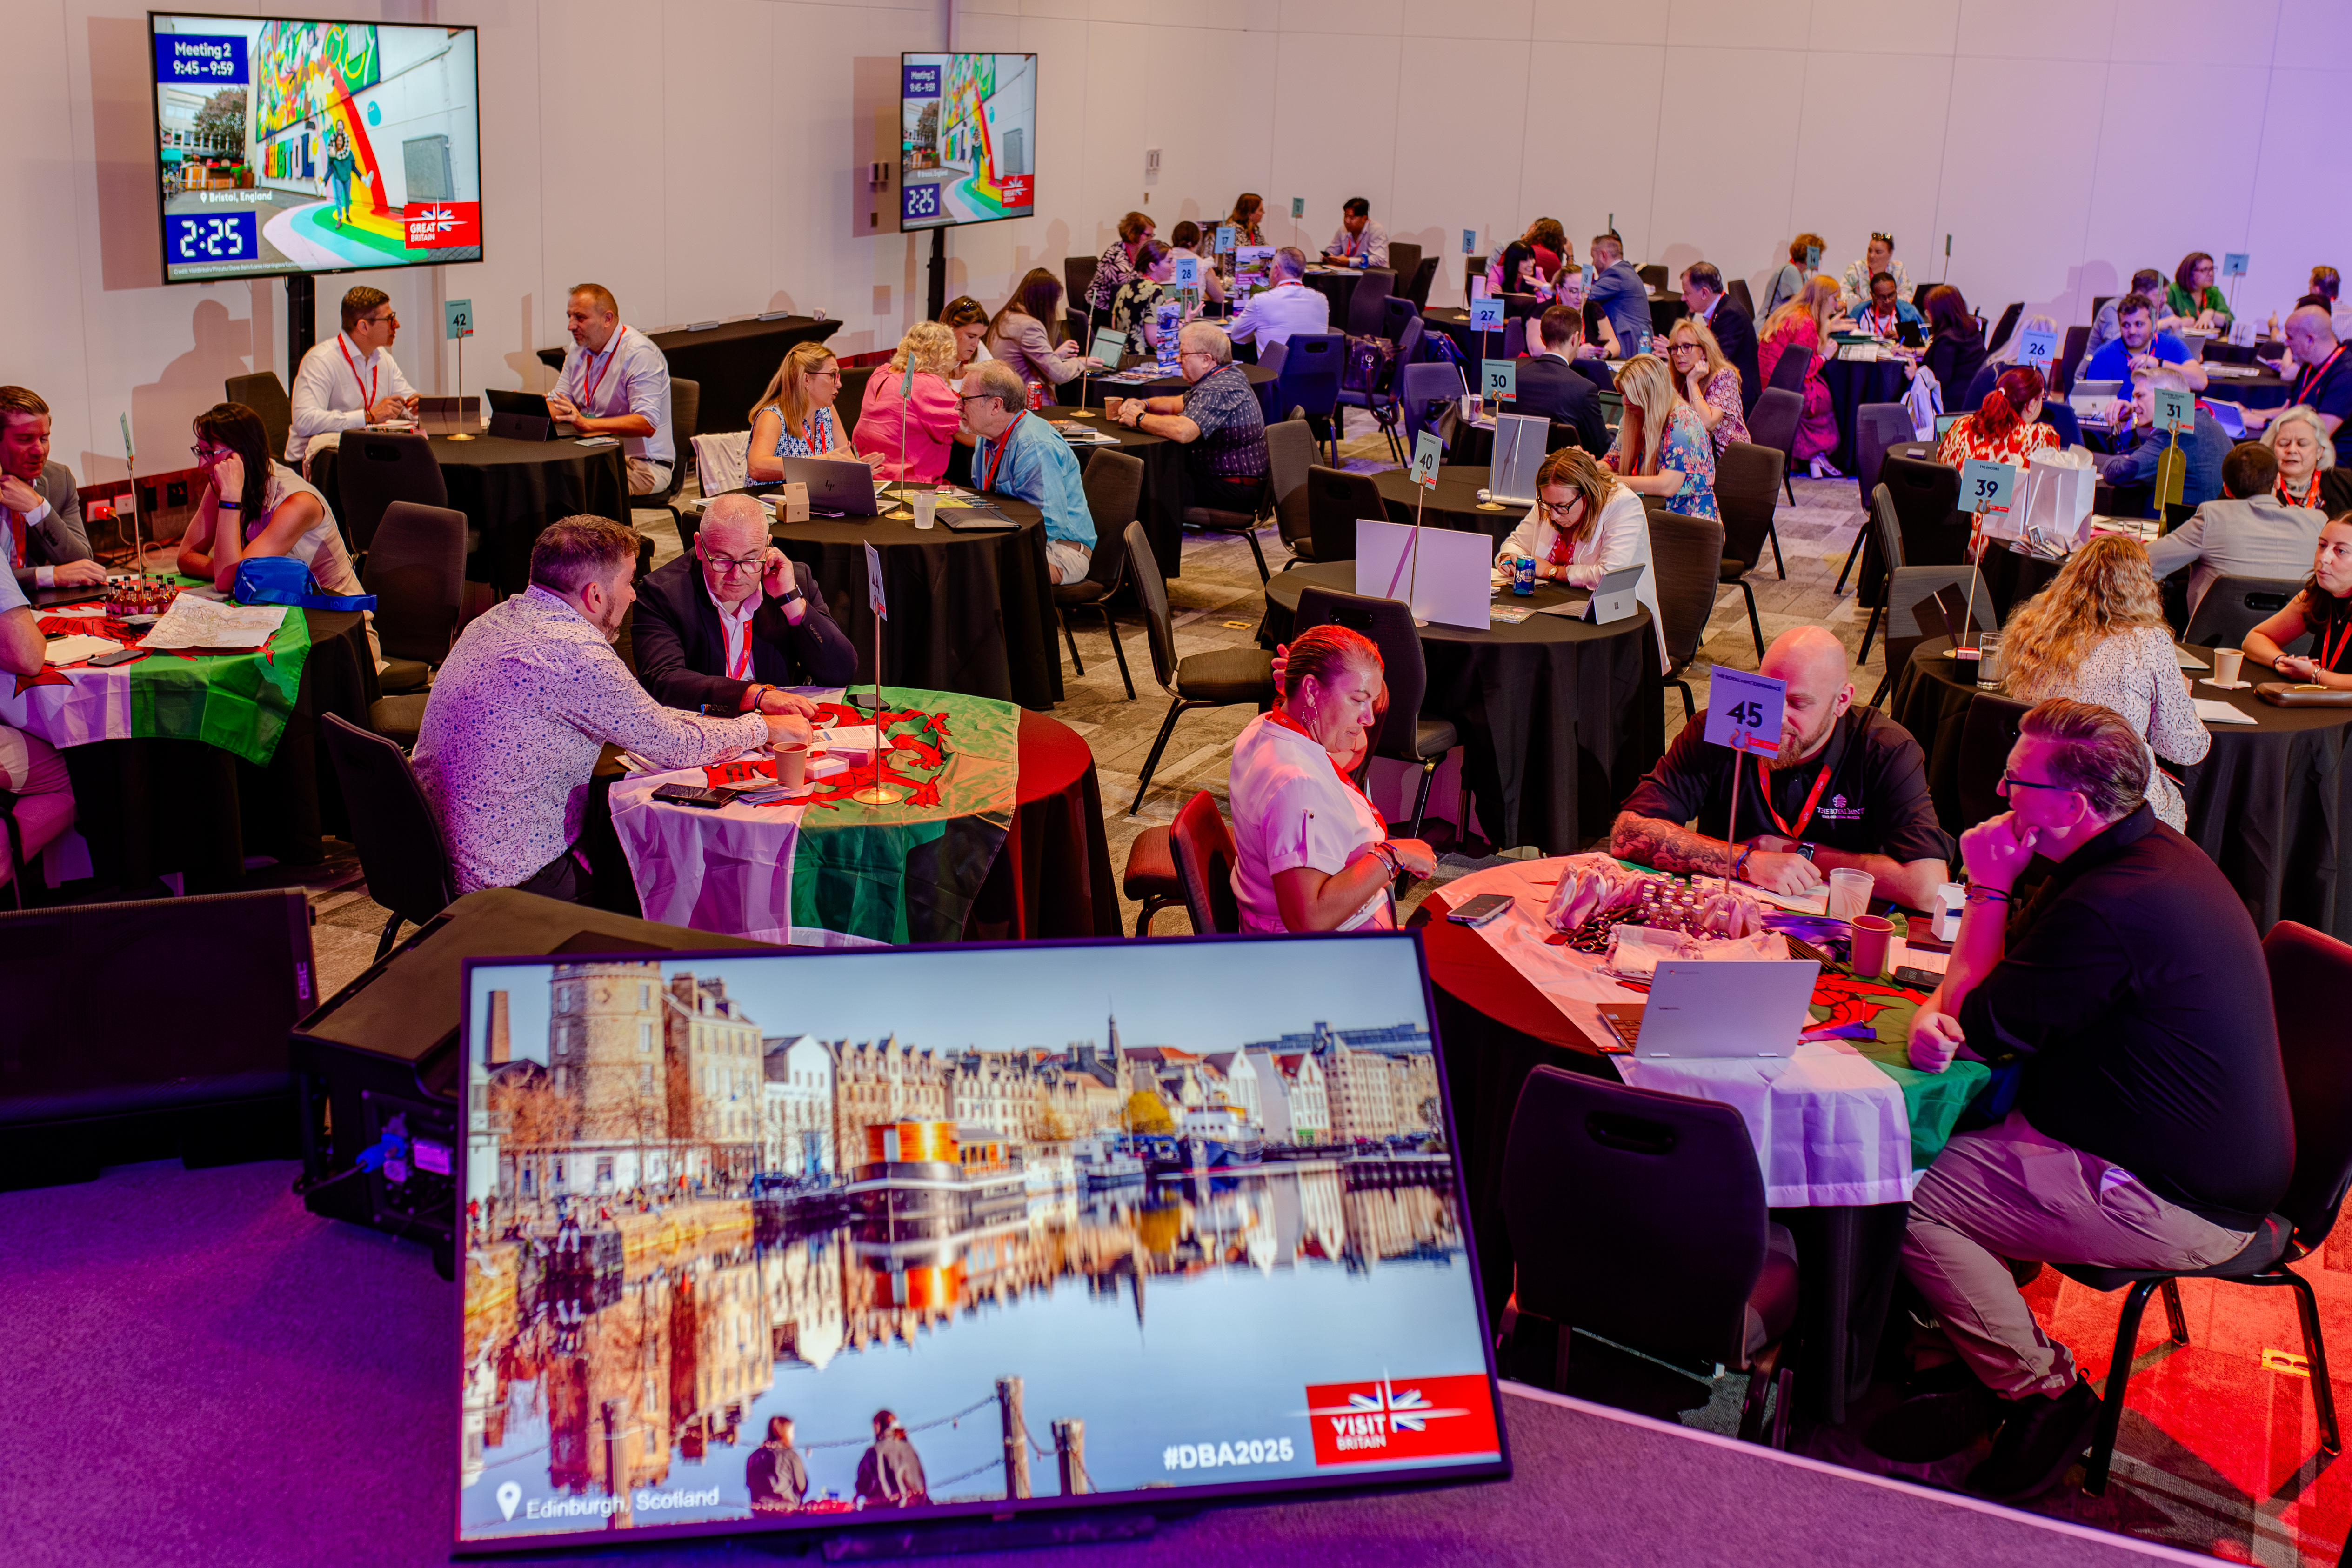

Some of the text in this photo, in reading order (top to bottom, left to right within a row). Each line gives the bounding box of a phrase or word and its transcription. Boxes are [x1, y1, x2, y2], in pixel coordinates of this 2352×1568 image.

[174, 41, 232, 60] Meeting 2
[173, 60, 200, 75] 9:45
[210, 60, 234, 76] 9:59
[264, 133, 314, 178] BRISTOL
[209, 190, 273, 203] Bristol, England
[908, 187, 935, 214] 2:25
[410, 222, 436, 234] GREAT
[180, 218, 243, 257] 2:25
[411, 233, 435, 242] BRITAIN
[1182, 269, 1191, 279] 28
[453, 313, 466, 327] 42
[1480, 310, 1495, 321] 27
[2029, 343, 2045, 355] 26
[1491, 374, 1507, 388] 30
[2167, 403, 2181, 419] 31
[1419, 452, 1433, 470] 40
[1974, 479, 1999, 498] 39
[872, 570, 880, 595] 44
[1725, 674, 1740, 683] ROYAL
[1752, 681, 1782, 692] EXPERIENCE
[1726, 701, 1763, 728] 45
[1330, 1412, 1386, 1436] VISIT
[1336, 1434, 1387, 1451] BRITAIN
[1163, 1437, 1294, 1470] #DBA2025
[526, 1485, 720, 1520] Edinburgh, Scotland
